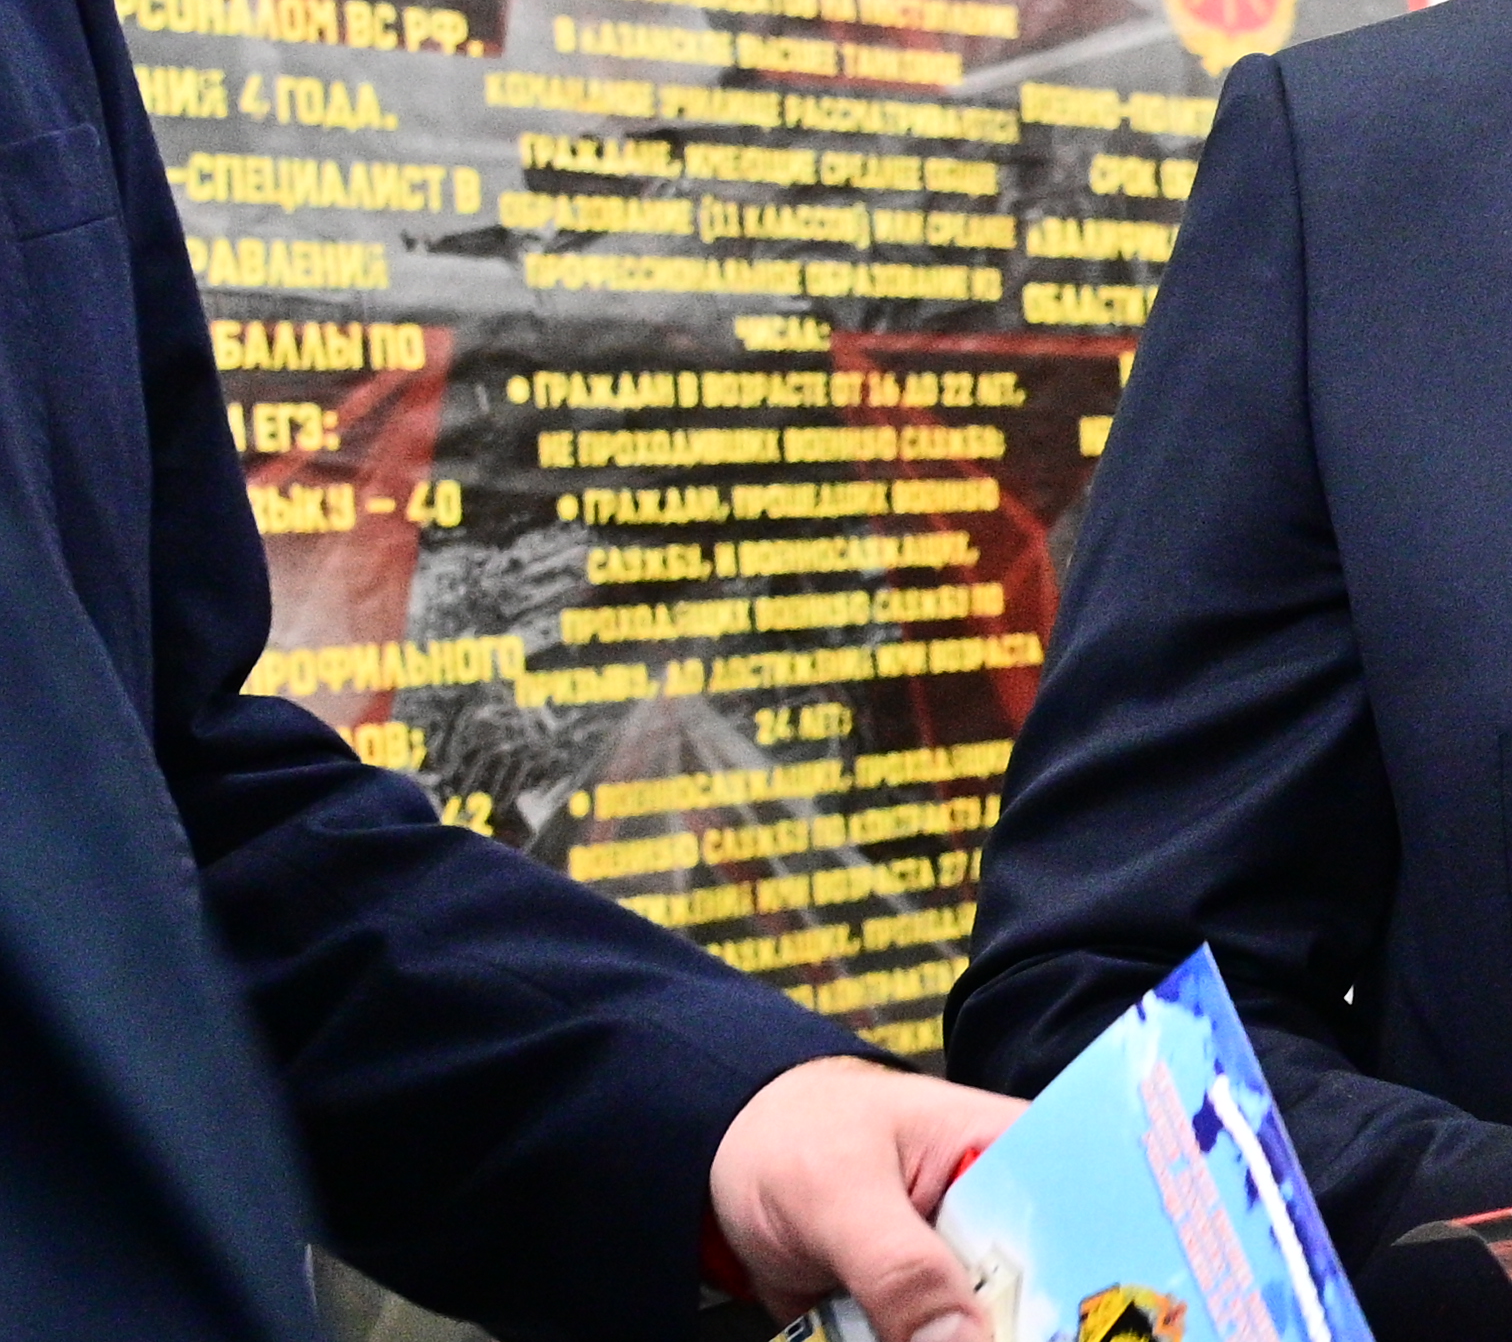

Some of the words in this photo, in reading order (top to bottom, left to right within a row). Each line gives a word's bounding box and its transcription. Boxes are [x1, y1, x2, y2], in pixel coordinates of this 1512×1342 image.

[345, 0, 399, 51] ВС
[239, 72, 272, 121] 4
[275, 75, 399, 131] ГОДА.
[210, 319, 365, 371] БАЛЛЫ
[367, 322, 426, 371] ПО
[252, 402, 341, 453] ЕГЭ:
[406, 479, 464, 529] 40
